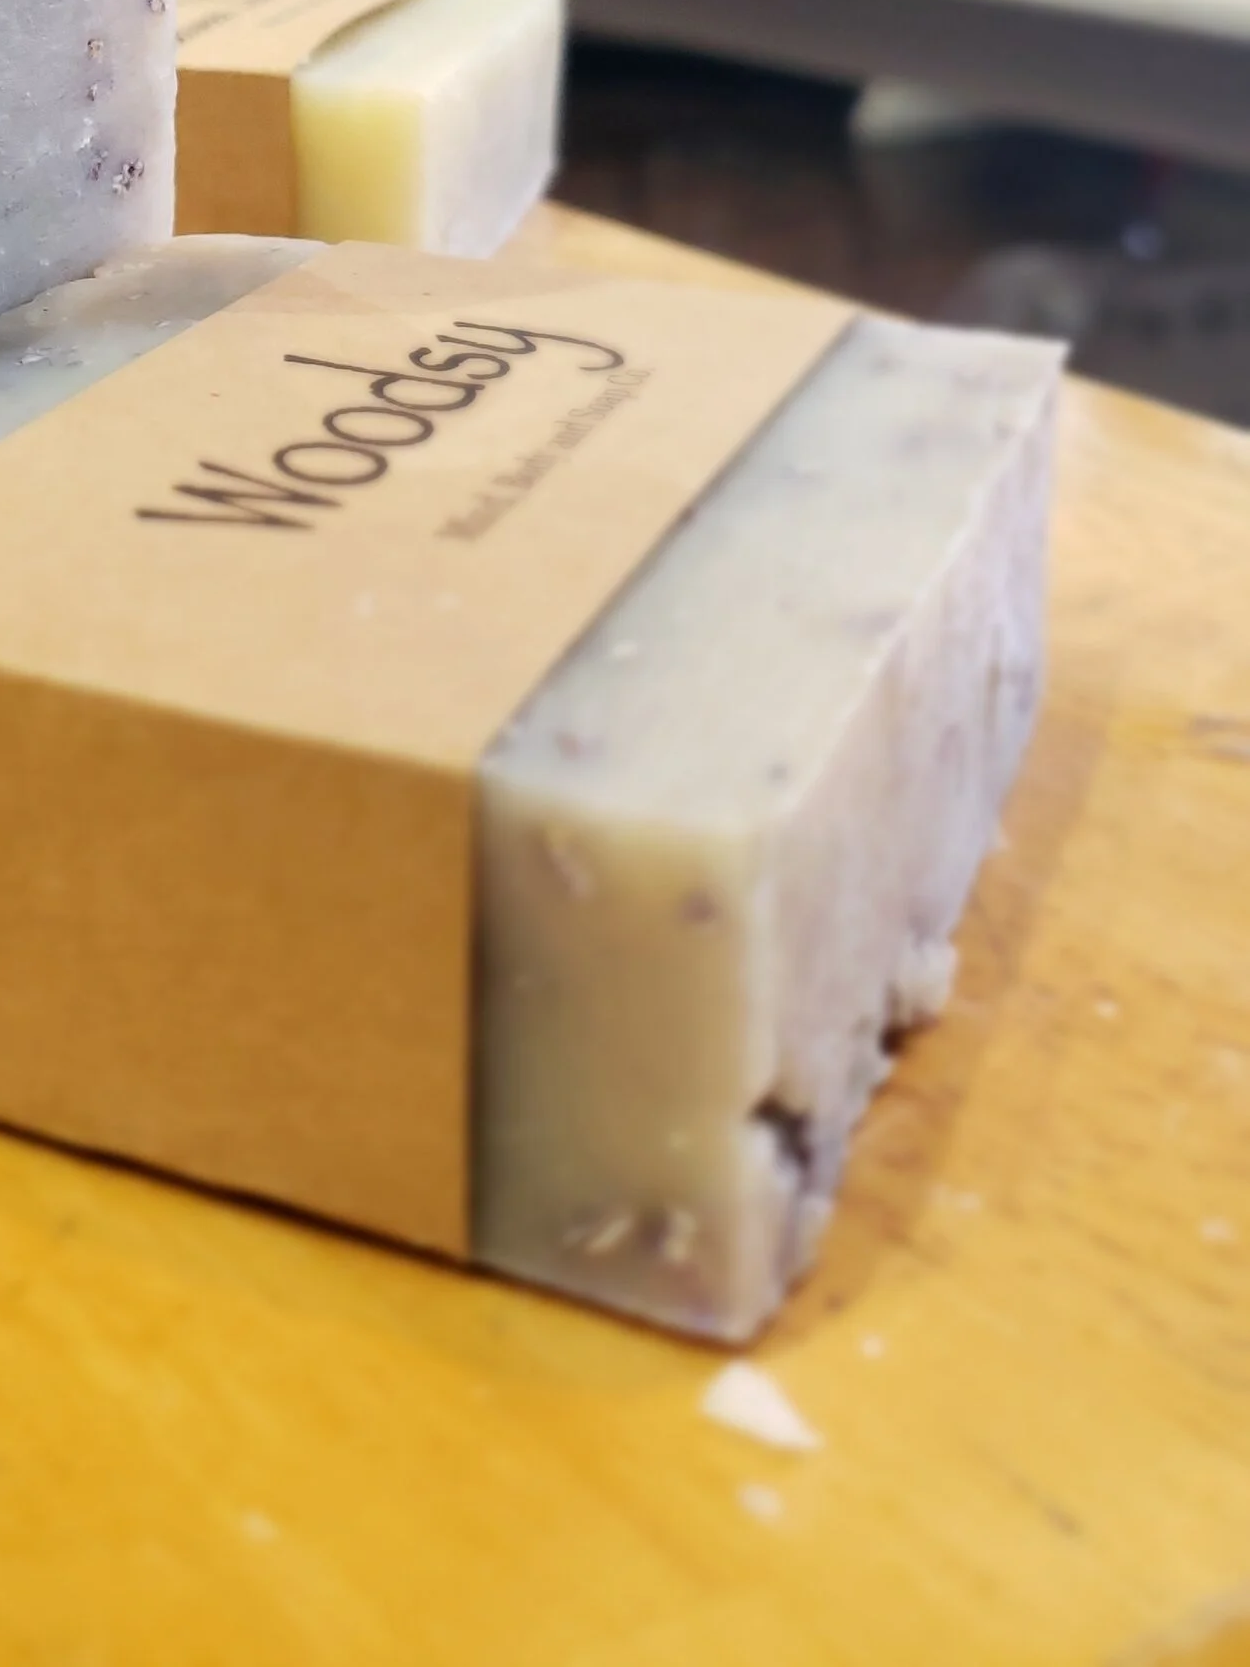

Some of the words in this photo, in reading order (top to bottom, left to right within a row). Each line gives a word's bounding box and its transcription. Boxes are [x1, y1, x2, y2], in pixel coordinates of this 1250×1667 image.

[567, 387, 640, 420] Soap
[135, 320, 625, 531] Woodsy
[551, 419, 594, 450] and
